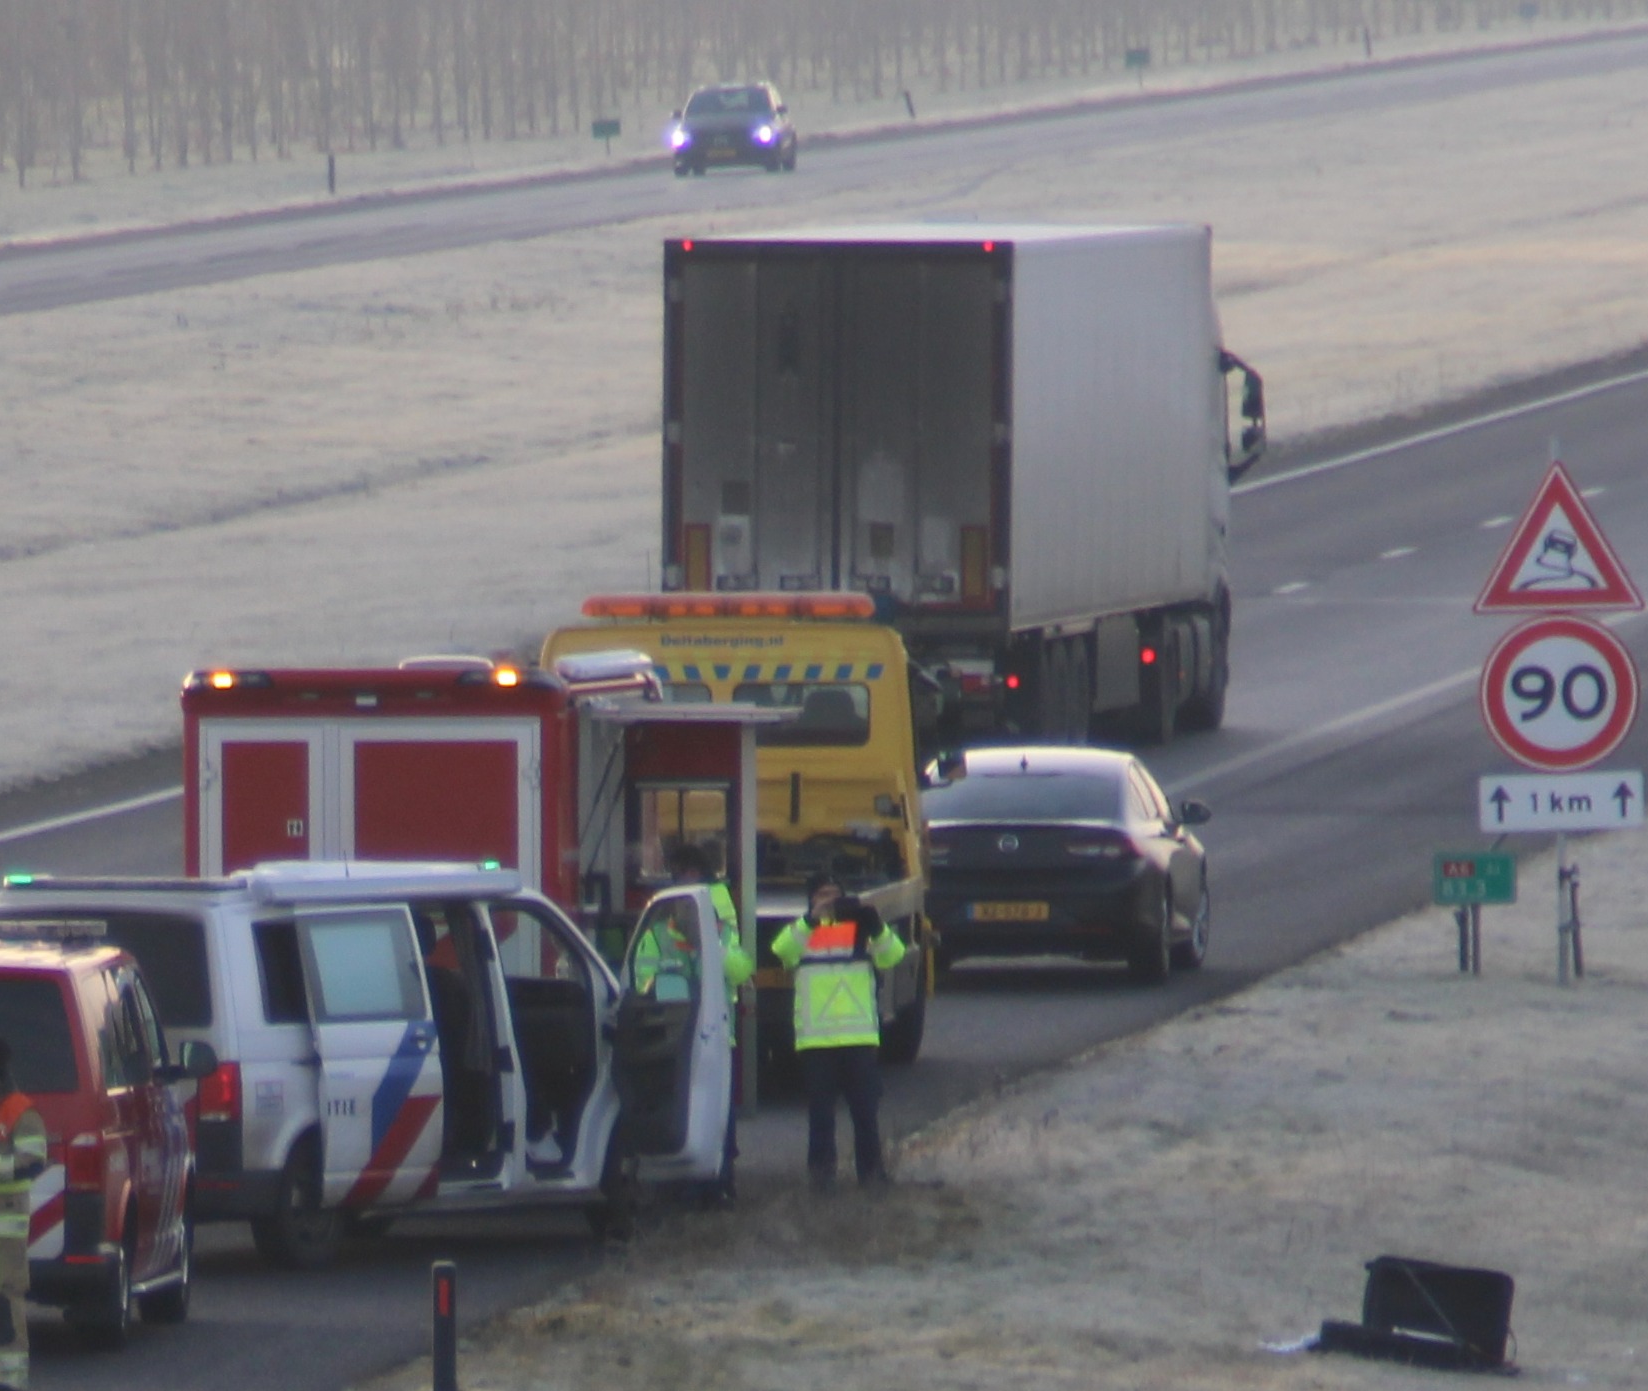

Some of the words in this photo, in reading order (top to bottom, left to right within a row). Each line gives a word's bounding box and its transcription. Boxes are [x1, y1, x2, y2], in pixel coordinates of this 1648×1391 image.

[1511, 664, 1608, 722] 90
[1530, 791, 1538, 813] 1
[1549, 791, 1593, 813] km
